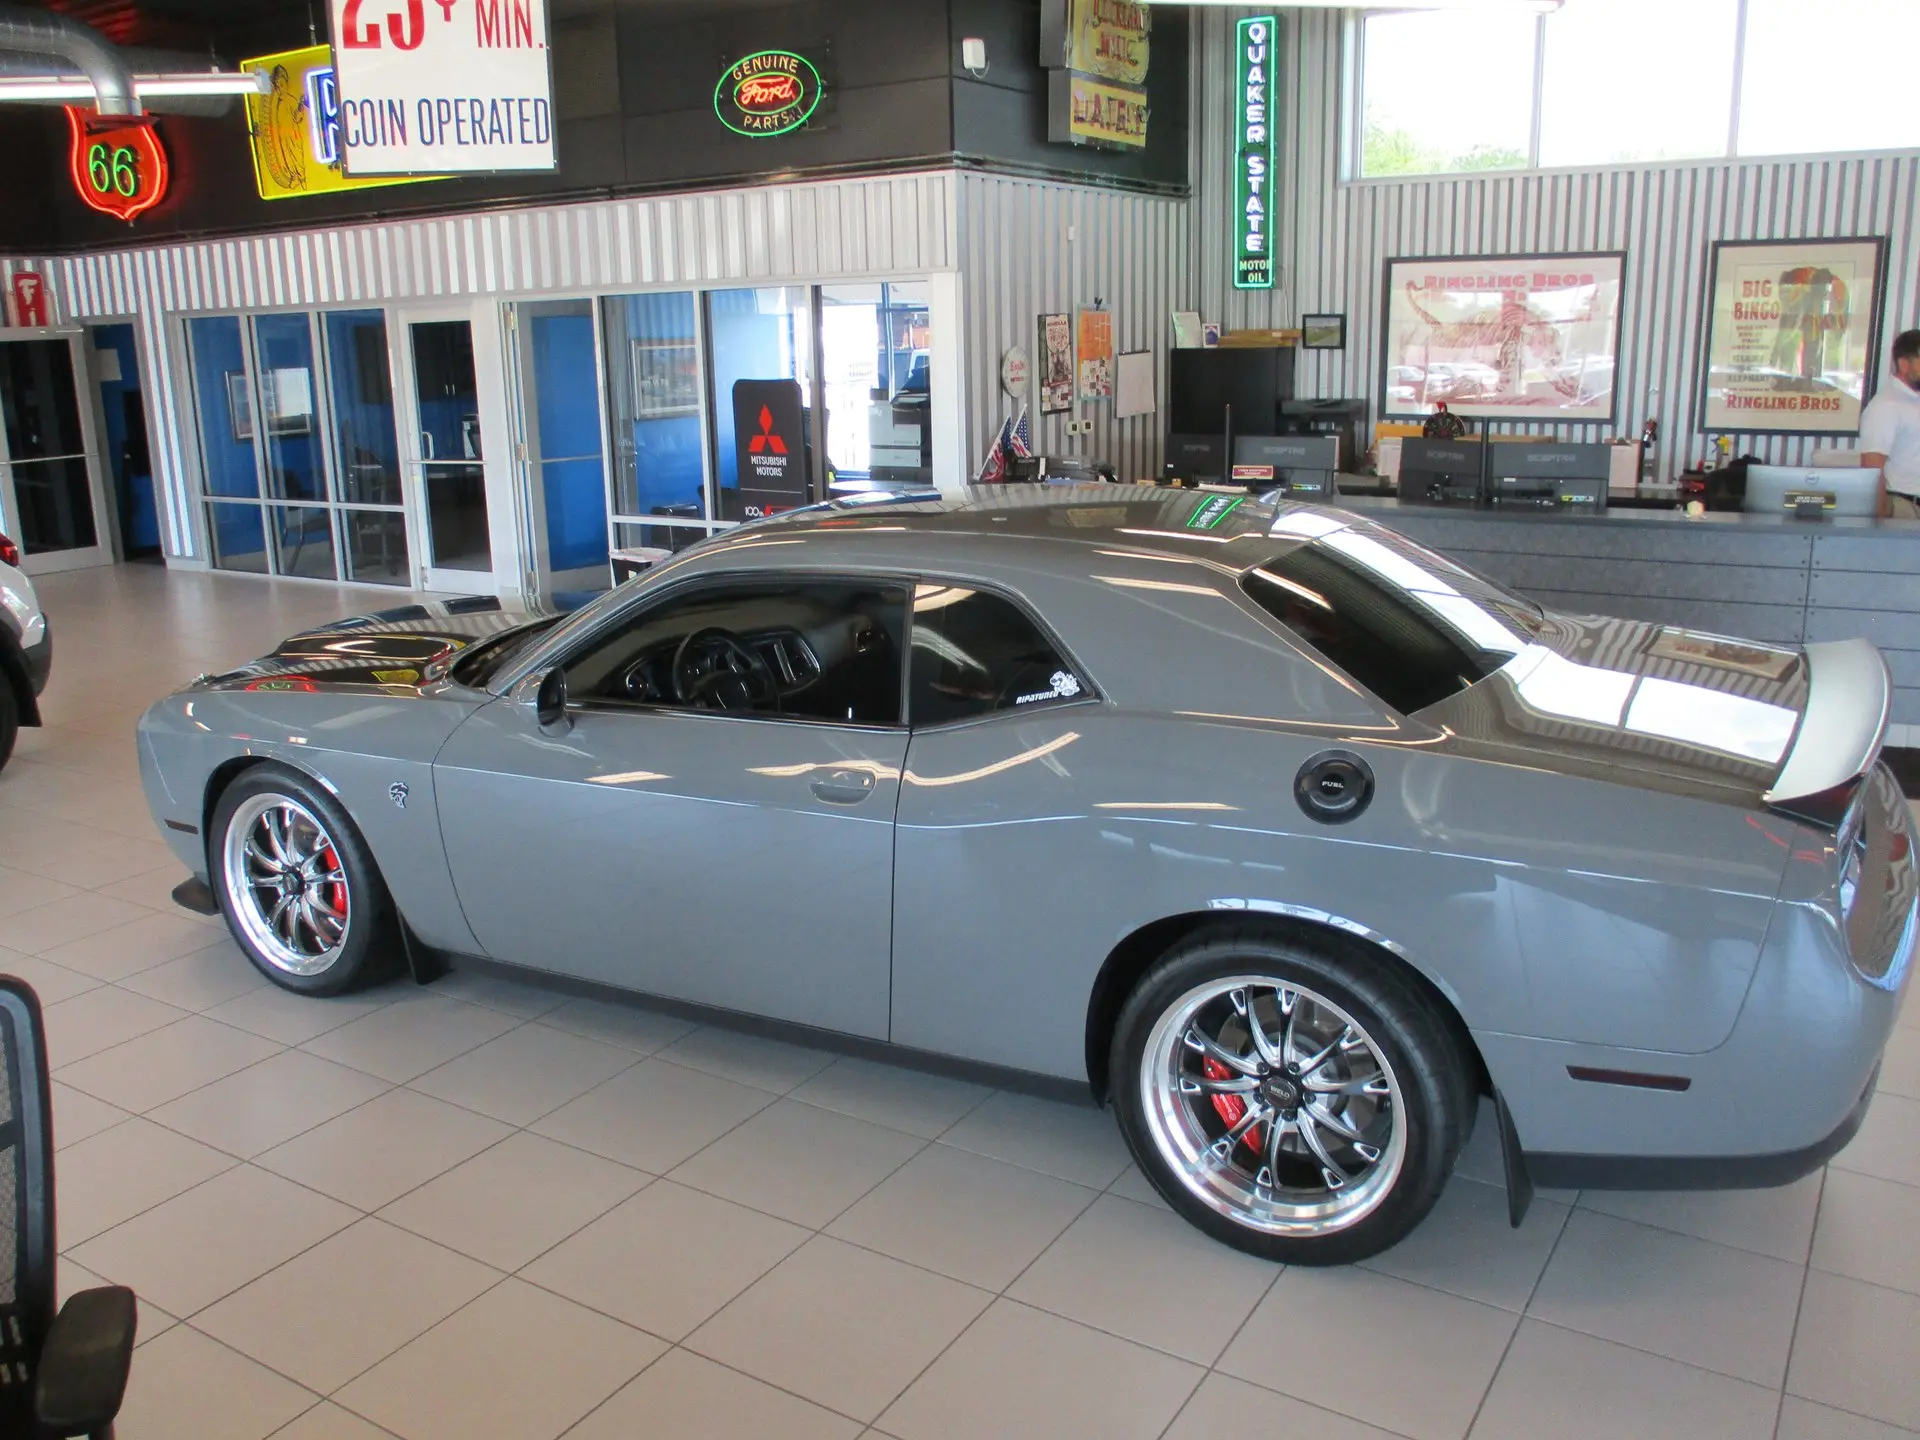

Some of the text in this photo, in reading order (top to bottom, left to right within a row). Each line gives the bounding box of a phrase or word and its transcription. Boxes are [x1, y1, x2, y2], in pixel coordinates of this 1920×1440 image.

[475, 0, 544, 49] MIN.
[733, 55, 799, 80] GENUINE
[741, 76, 795, 104] Ford
[342, 98, 408, 148] COIN
[417, 97, 550, 146] OPERATED
[743, 112, 790, 129] PARTS
[1246, 22, 1267, 252] QUAKER STATE
[88, 144, 135, 197] 66
[1247, 272, 1264, 283] OIL
[1423, 272, 1595, 289] RINGLING BROS
[1742, 279, 1773, 298] BIG
[1733, 300, 1781, 321] BINGO
[1726, 394, 1841, 411] RINGLING BROS
[750, 455, 787, 467] MITSUBISHI
[756, 467, 783, 477] MOTORS
[1321, 781, 1345, 789] FUEL
